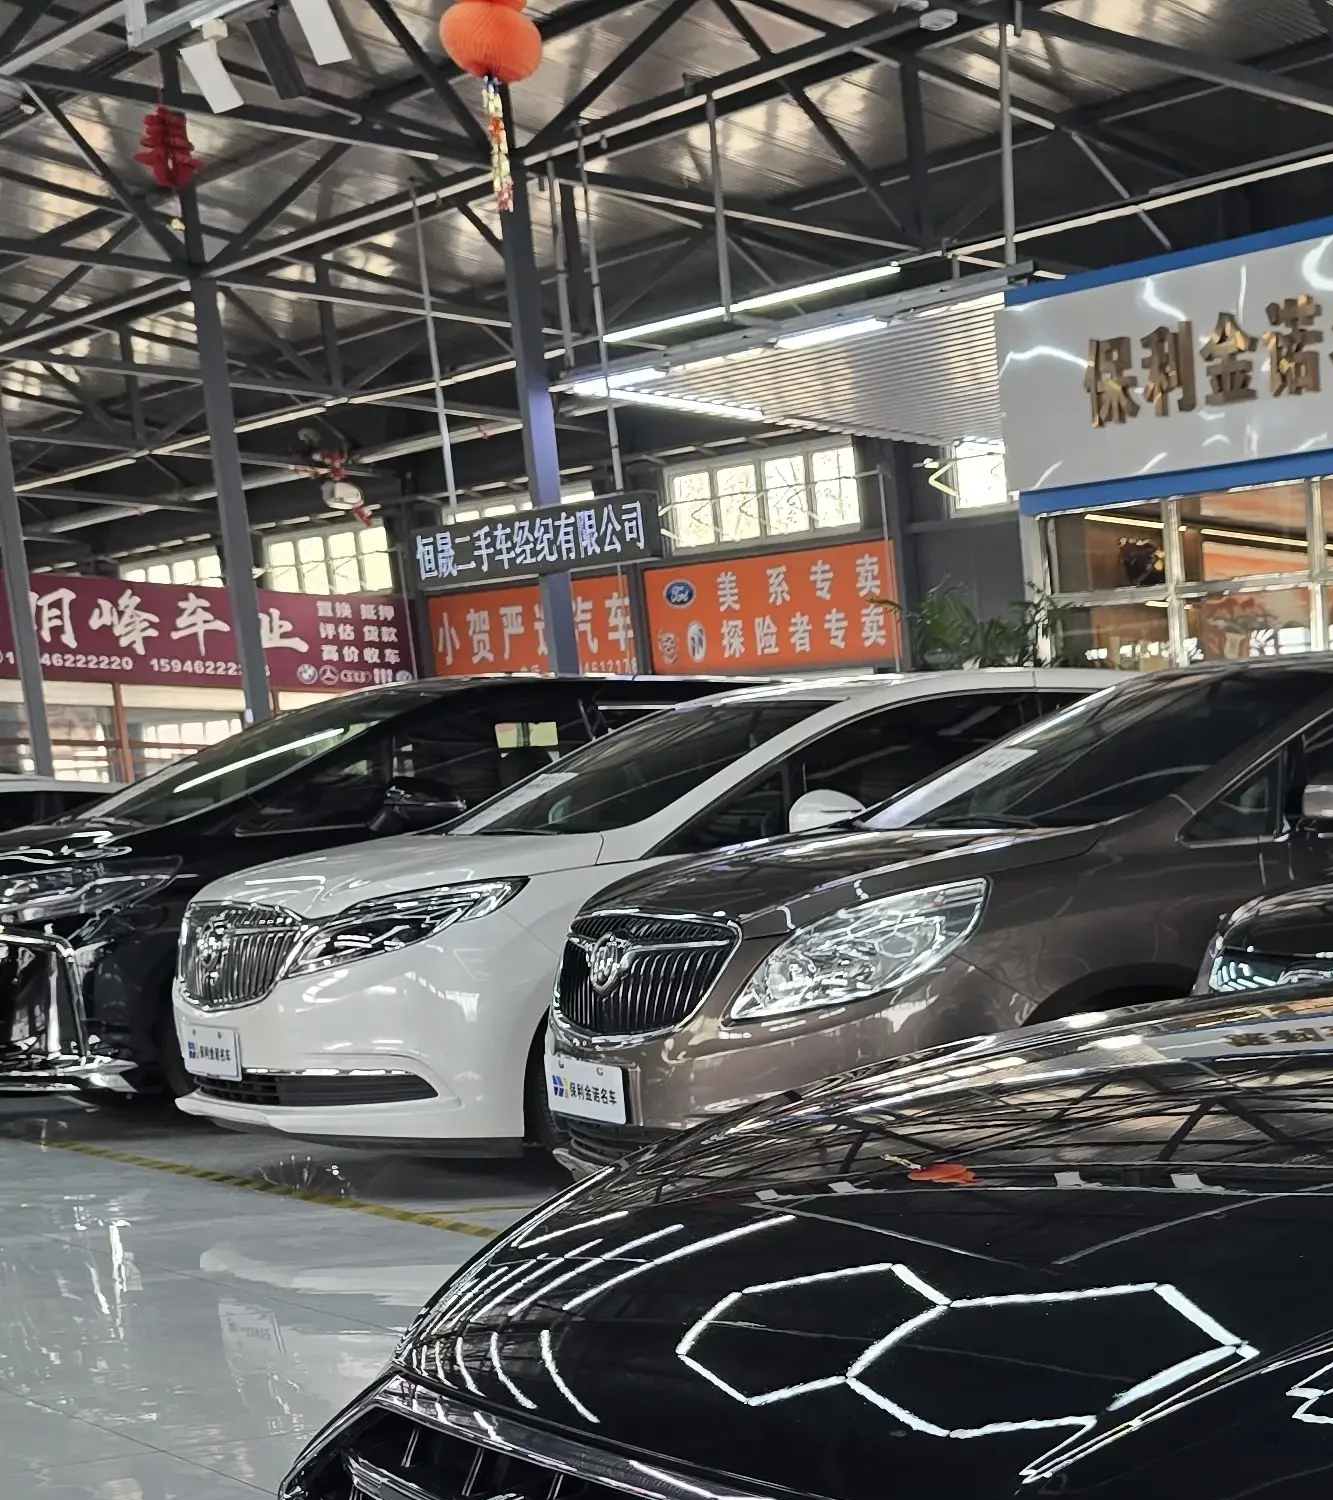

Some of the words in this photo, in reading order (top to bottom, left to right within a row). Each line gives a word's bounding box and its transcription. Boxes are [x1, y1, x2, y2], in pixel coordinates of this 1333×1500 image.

[415, 500, 645, 581] 恒晟二手车经纪有限公司
[716, 553, 881, 612] 美系专卖
[720, 603, 887, 659] 探险者专卖
[569, 1082, 617, 1106] 保利金诺名车
